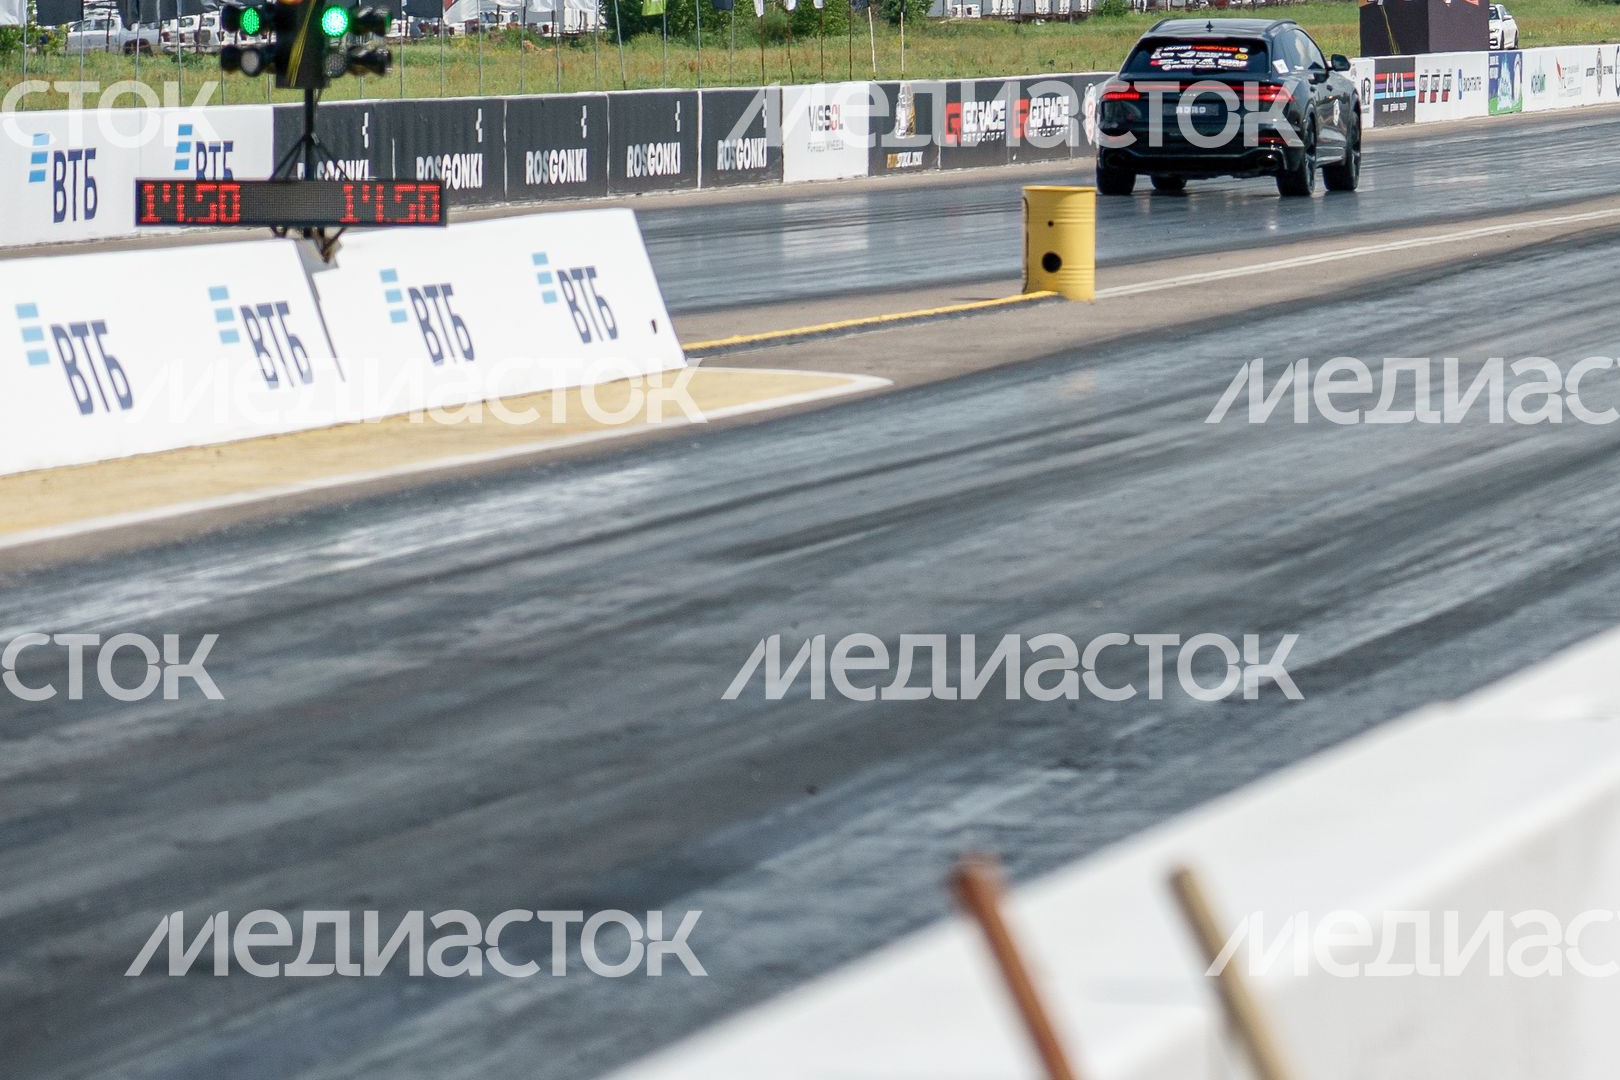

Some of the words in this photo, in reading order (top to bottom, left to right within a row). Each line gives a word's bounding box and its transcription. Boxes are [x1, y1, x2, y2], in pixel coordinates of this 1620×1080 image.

[808, 104, 844, 132] VISSOL
[196, 140, 234, 180] ВТБ
[297, 159, 370, 181] RSGONKI
[416, 153, 483, 190] ROSGONKI
[525, 148, 588, 185] ROSGONKI
[626, 141, 682, 178] ROSGONKI
[716, 137, 768, 171] ROSGONKI
[53, 148, 98, 223] ВТБ
[140, 183, 241, 223] 14.50
[339, 183, 441, 223] 14.50
[407, 283, 475, 366] ВТБ
[557, 265, 618, 344] ВТБ
[240, 300, 313, 389] ВТБ
[49, 319, 133, 415] ВТБ
